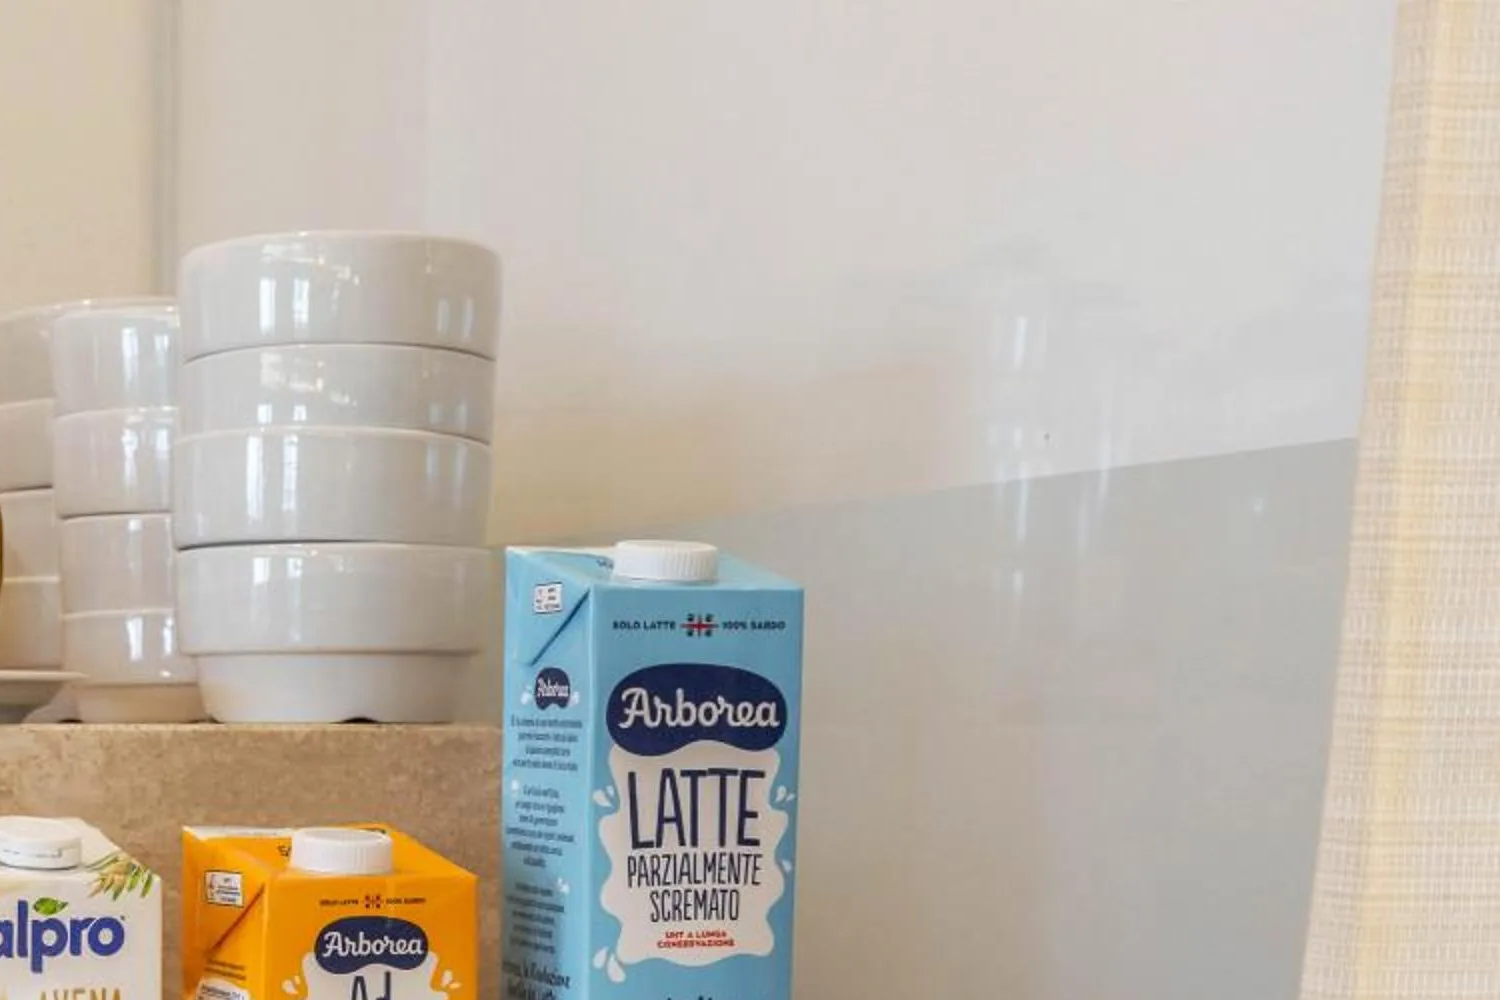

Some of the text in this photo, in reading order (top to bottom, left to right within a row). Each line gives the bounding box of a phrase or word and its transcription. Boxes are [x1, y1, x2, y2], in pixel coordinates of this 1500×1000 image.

[643, 620, 677, 630] LATTE
[618, 686, 781, 729] Arborea
[627, 767, 766, 850] LATTE
[627, 852, 763, 888] PARZIALMENTE
[650, 888, 740, 923] SCREMATO
[322, 931, 424, 958] Arborea
